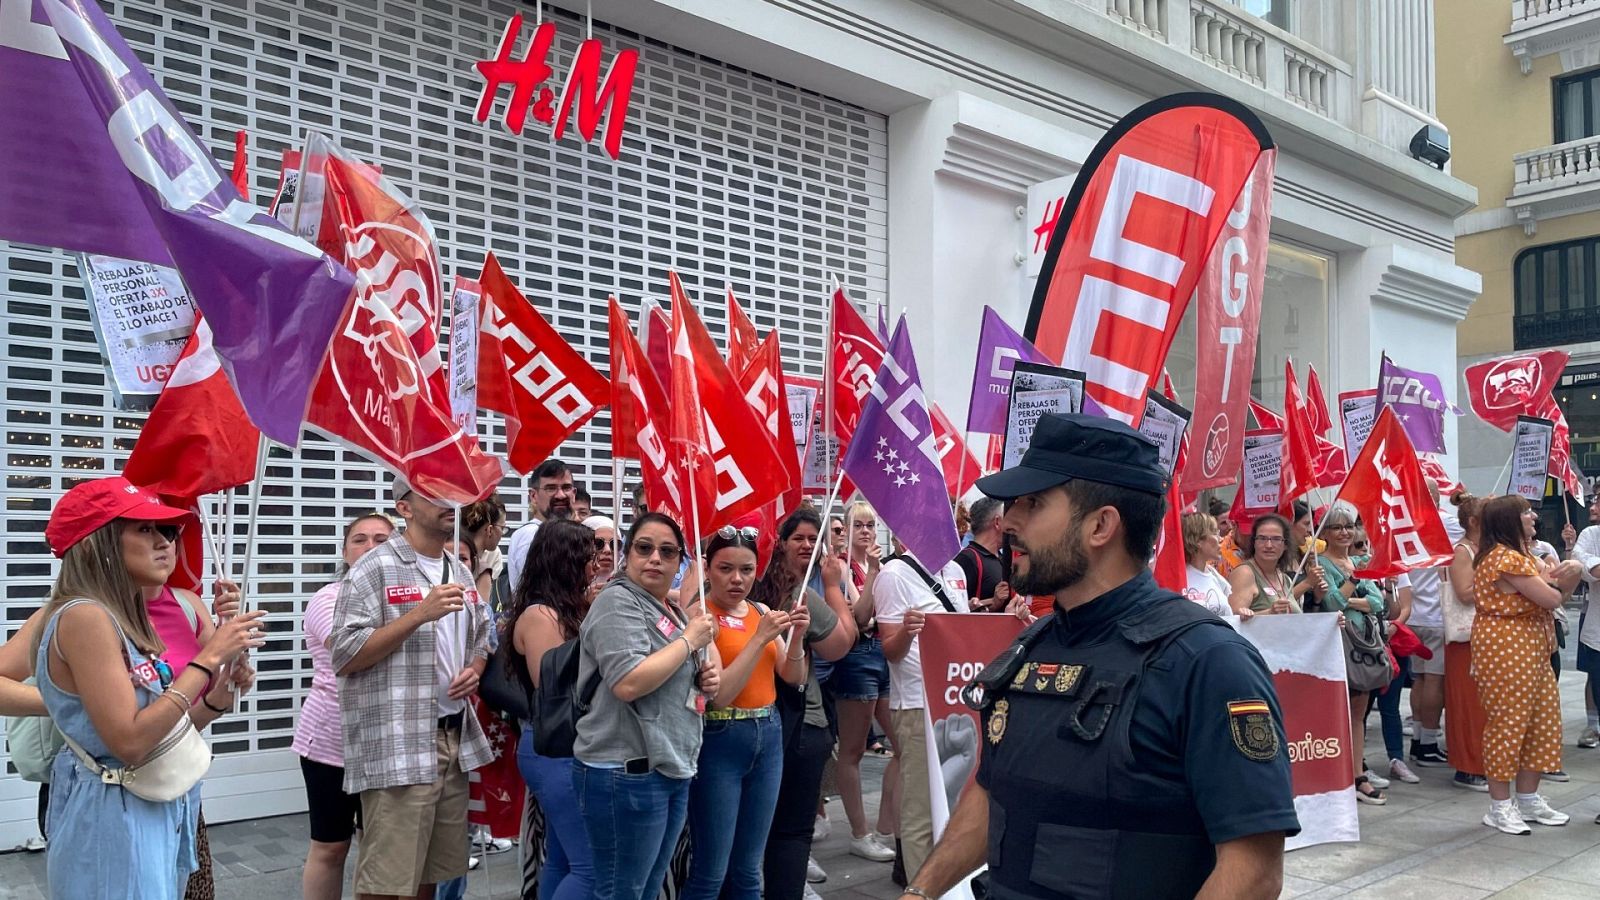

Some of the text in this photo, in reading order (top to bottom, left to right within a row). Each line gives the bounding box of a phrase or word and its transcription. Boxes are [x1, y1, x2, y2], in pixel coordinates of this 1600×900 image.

[471, 12, 639, 160] H&M
[97, 263, 158, 282] REBAJAS DE
[102, 277, 161, 294] PERSONAL:
[109, 287, 168, 306] OFERTA 3X1
[114, 295, 188, 319] EL TRABAJO DE
[119, 310, 178, 332] 3 LO HACE 1
[988, 383, 1009, 395] mu
[1017, 399, 1059, 409] REBAJAS DE
[1018, 418, 1037, 427] OFER
[1018, 427, 1027, 435] EL
[1256, 494, 1277, 503] UGT
[388, 587, 420, 597] CCOO
